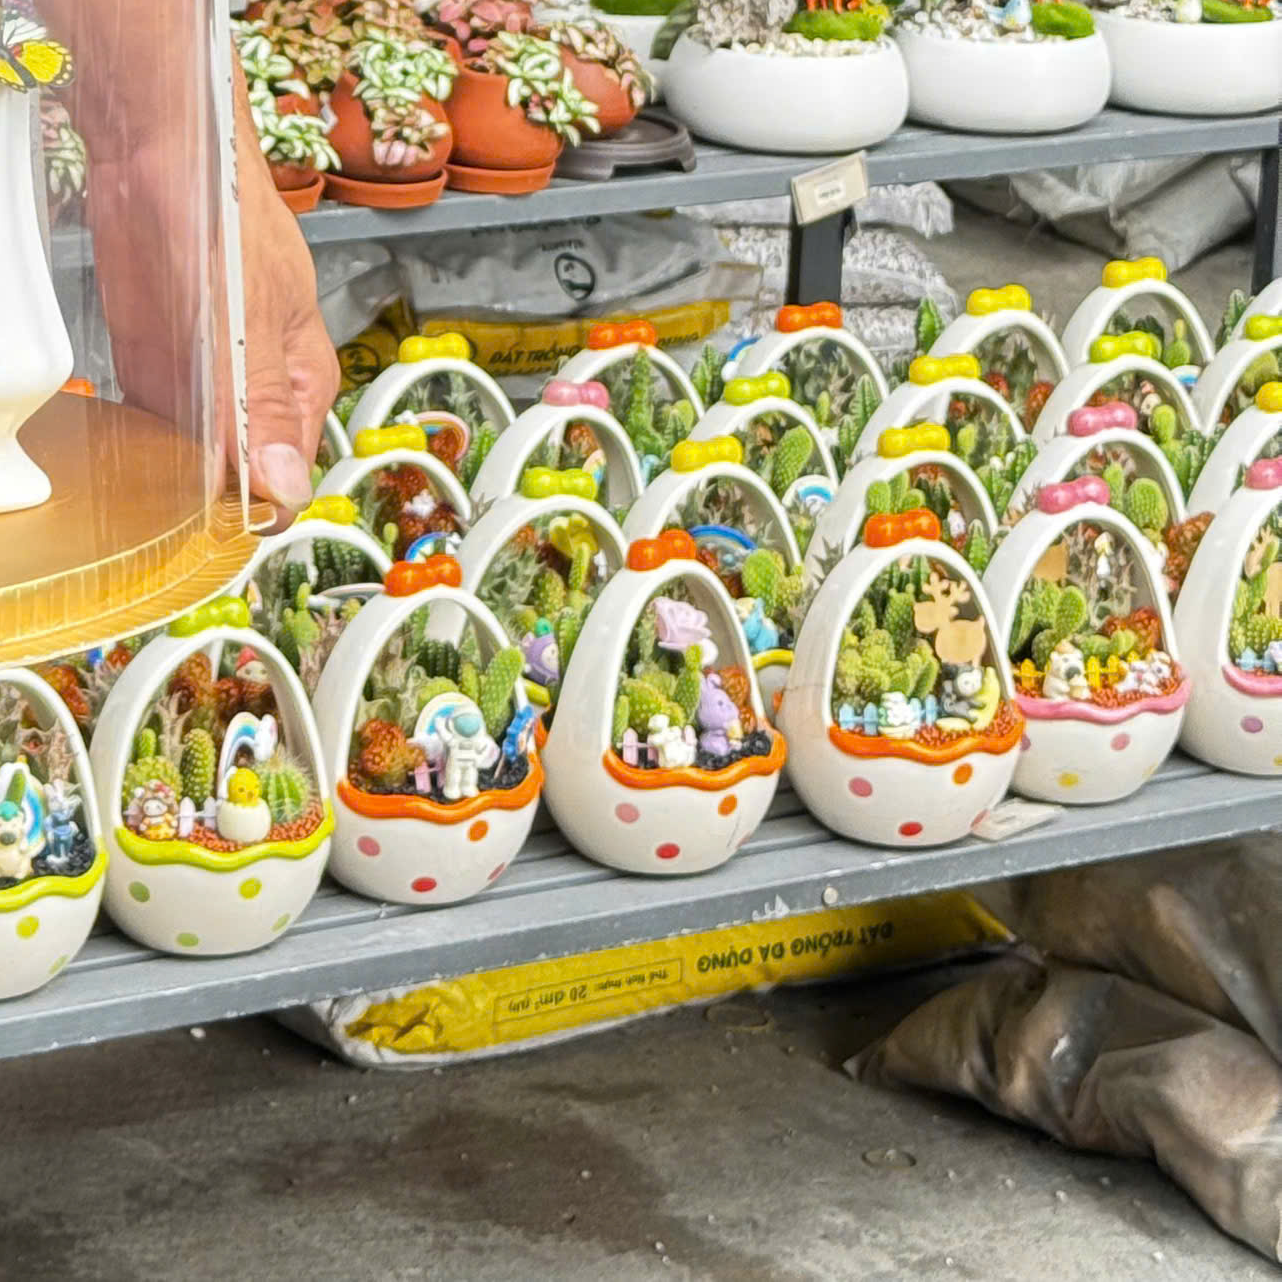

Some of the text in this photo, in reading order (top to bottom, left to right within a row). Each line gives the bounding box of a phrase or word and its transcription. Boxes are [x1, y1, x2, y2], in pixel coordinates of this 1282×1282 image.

[697, 945, 753, 972] DỤNG
[758, 942, 785, 963] ĐA
[569, 984, 588, 1001] 20
